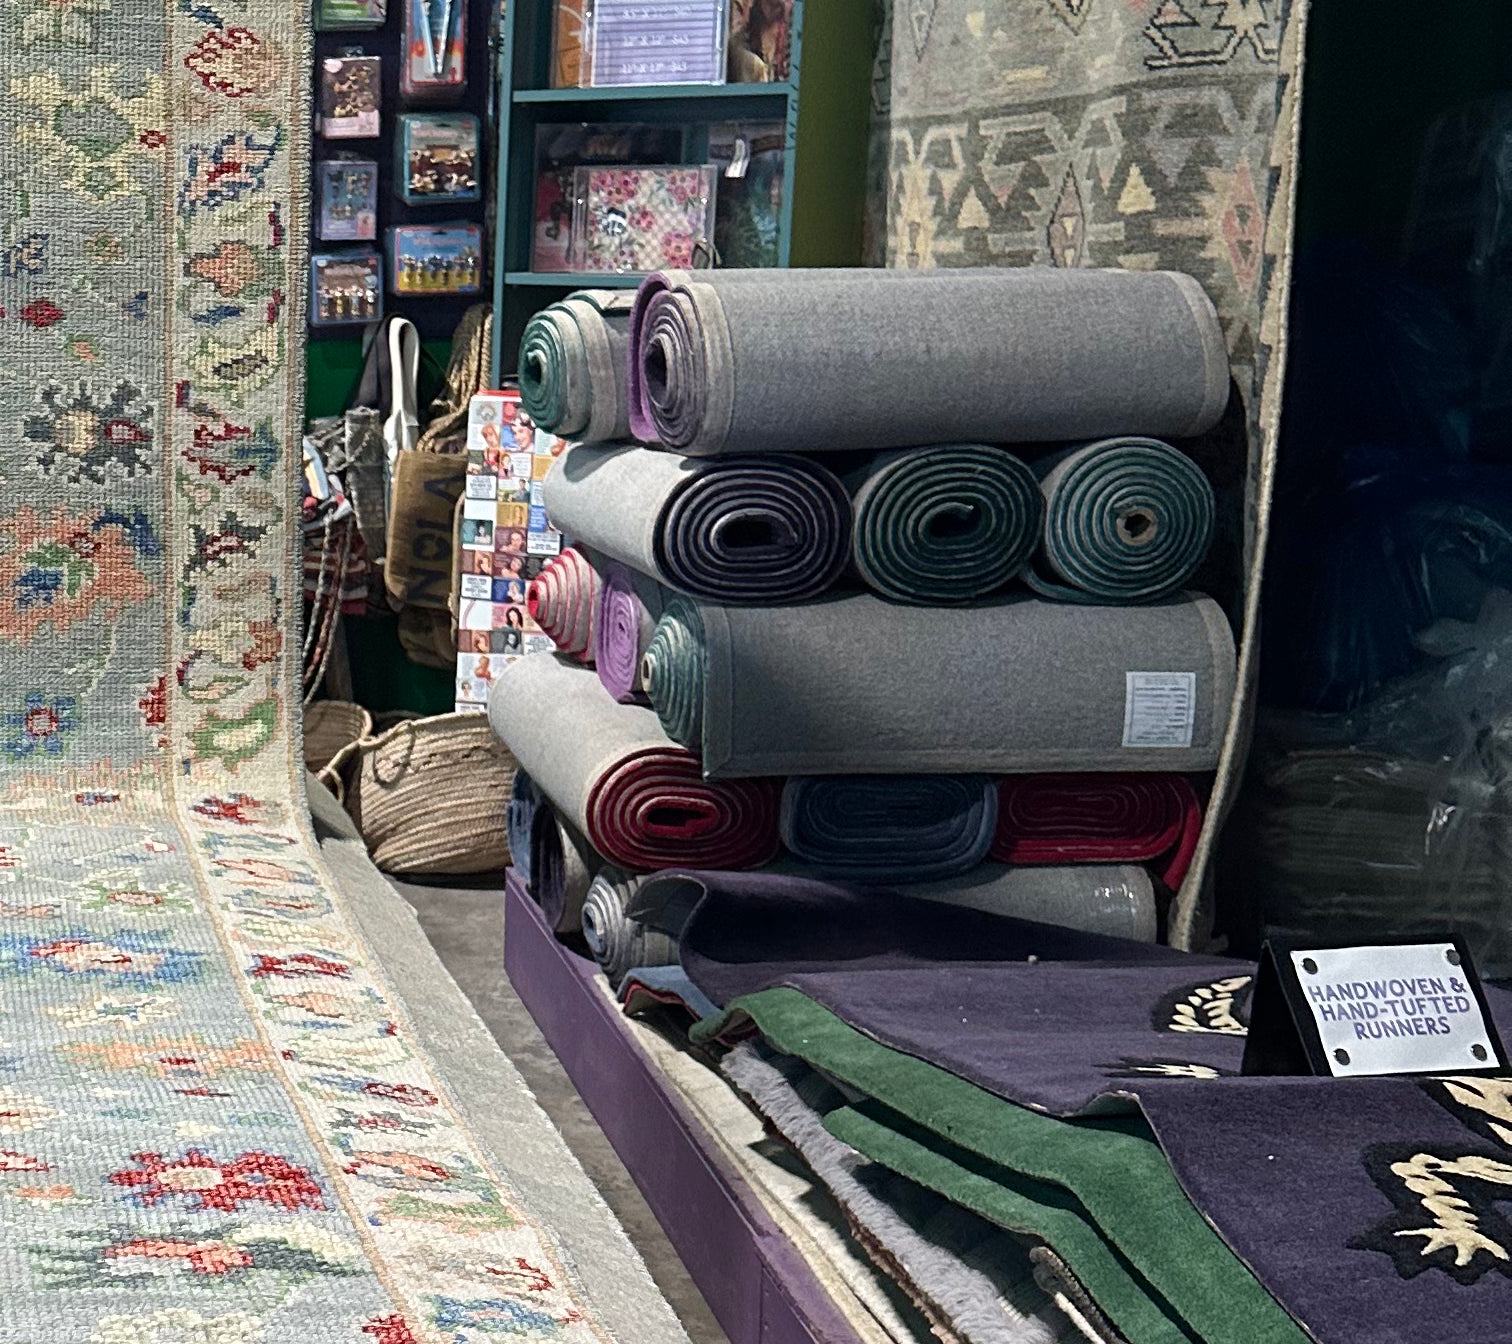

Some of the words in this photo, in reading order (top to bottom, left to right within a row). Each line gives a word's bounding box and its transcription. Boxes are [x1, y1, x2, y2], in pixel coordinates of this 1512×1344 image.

[406, 474, 467, 604] NOLA
[1307, 977, 1447, 1003] HANDWOVEN
[1449, 976, 1467, 994] &
[1319, 995, 1471, 1022] HAND-TUFTED
[1353, 1016, 1451, 1040] RUNNERS
